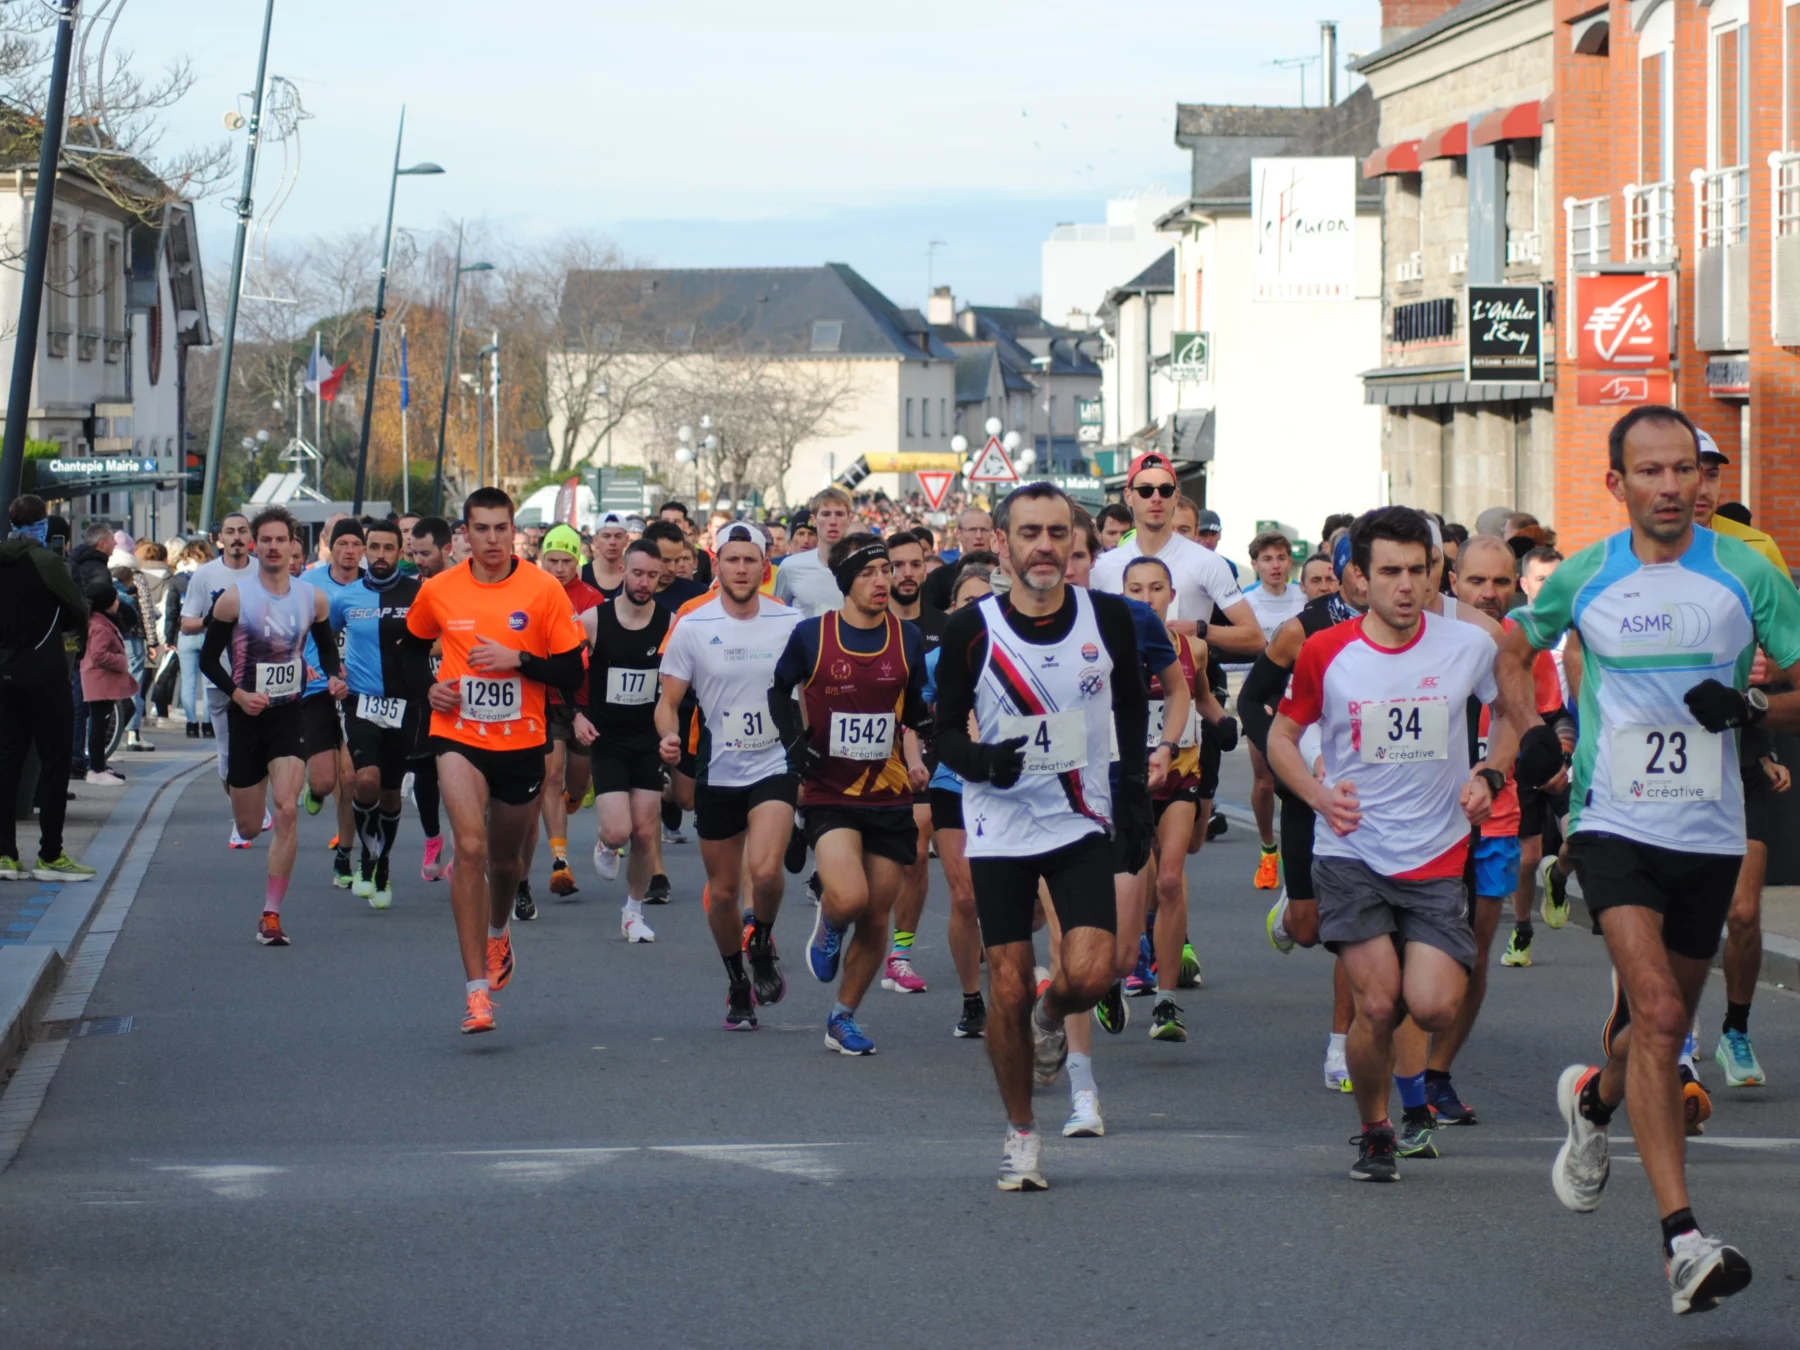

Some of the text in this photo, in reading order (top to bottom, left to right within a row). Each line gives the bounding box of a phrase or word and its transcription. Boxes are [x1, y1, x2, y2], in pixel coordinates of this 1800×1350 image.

[1472, 298, 1536, 321] L'Atelier
[1483, 320, 1530, 354] d'Emy
[49, 459, 139, 474] Chantepie Mairie
[1066, 477, 1100, 489] Mairie
[349, 607, 393, 619] ESCAP
[1620, 614, 1673, 634] ASMR
[265, 664, 296, 686] 209
[621, 672, 646, 693] 177
[466, 680, 514, 707] 1296
[364, 694, 400, 719] 1395
[743, 711, 763, 736] 31
[839, 717, 888, 744] 1542
[1388, 706, 1422, 741] 34
[1034, 720, 1052, 754] 4
[850, 750, 884, 759] créative
[1388, 748, 1435, 761] créative
[1646, 731, 1687, 775] 23
[1028, 759, 1076, 772] créative
[1646, 783, 1705, 798] créative
